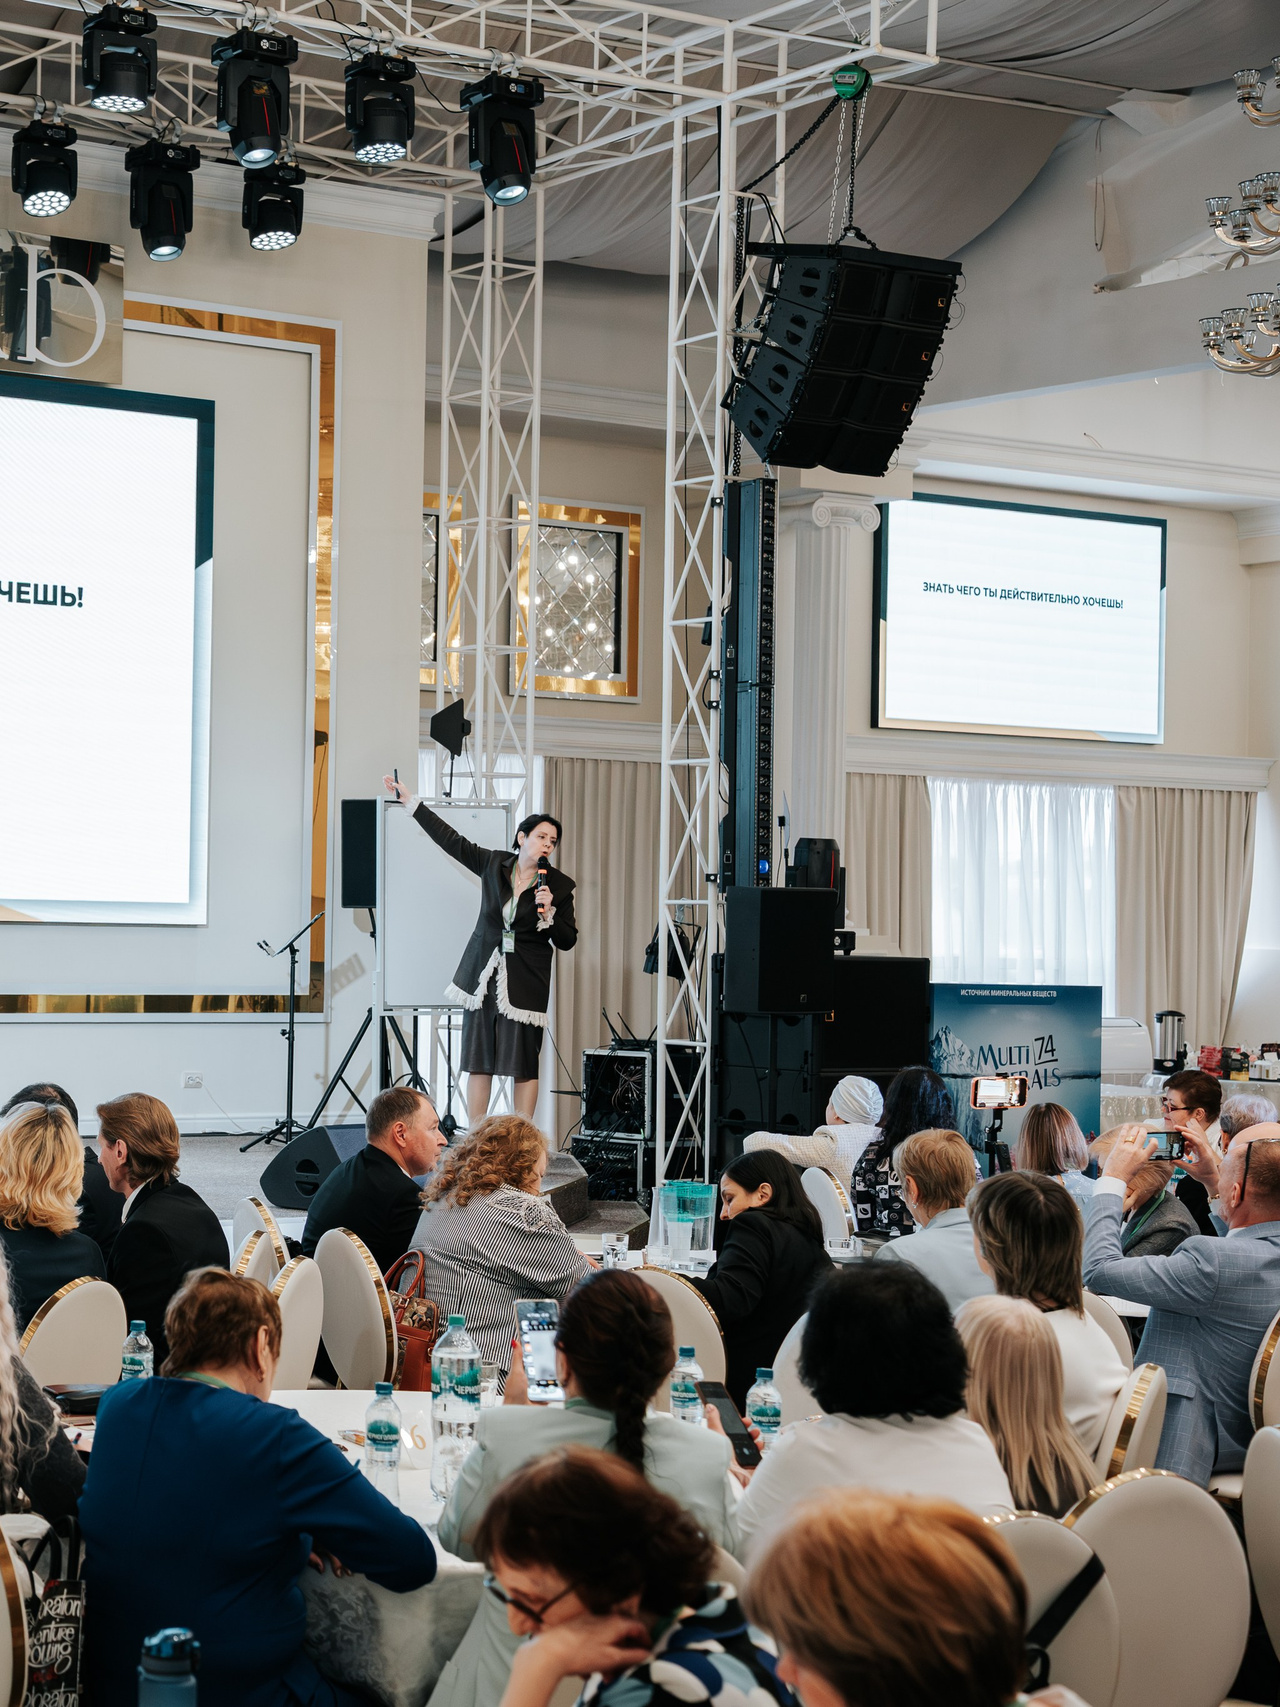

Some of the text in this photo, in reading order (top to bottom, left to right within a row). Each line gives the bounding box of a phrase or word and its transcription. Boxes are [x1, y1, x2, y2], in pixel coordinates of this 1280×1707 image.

[922, 581, 1124, 609] ЗНАТЬ ЧЕГО ТЫ ДЕЙСТВИТЕЛЬНО ХОЧЕШЬ!
[960, 989, 1058, 999] ИСТОЧНИК МИНЕРАЛЬНЫХ ВЕЩЕСТВ
[1033, 1034, 1057, 1062] 74
[410, 1424, 427, 1451] 6
